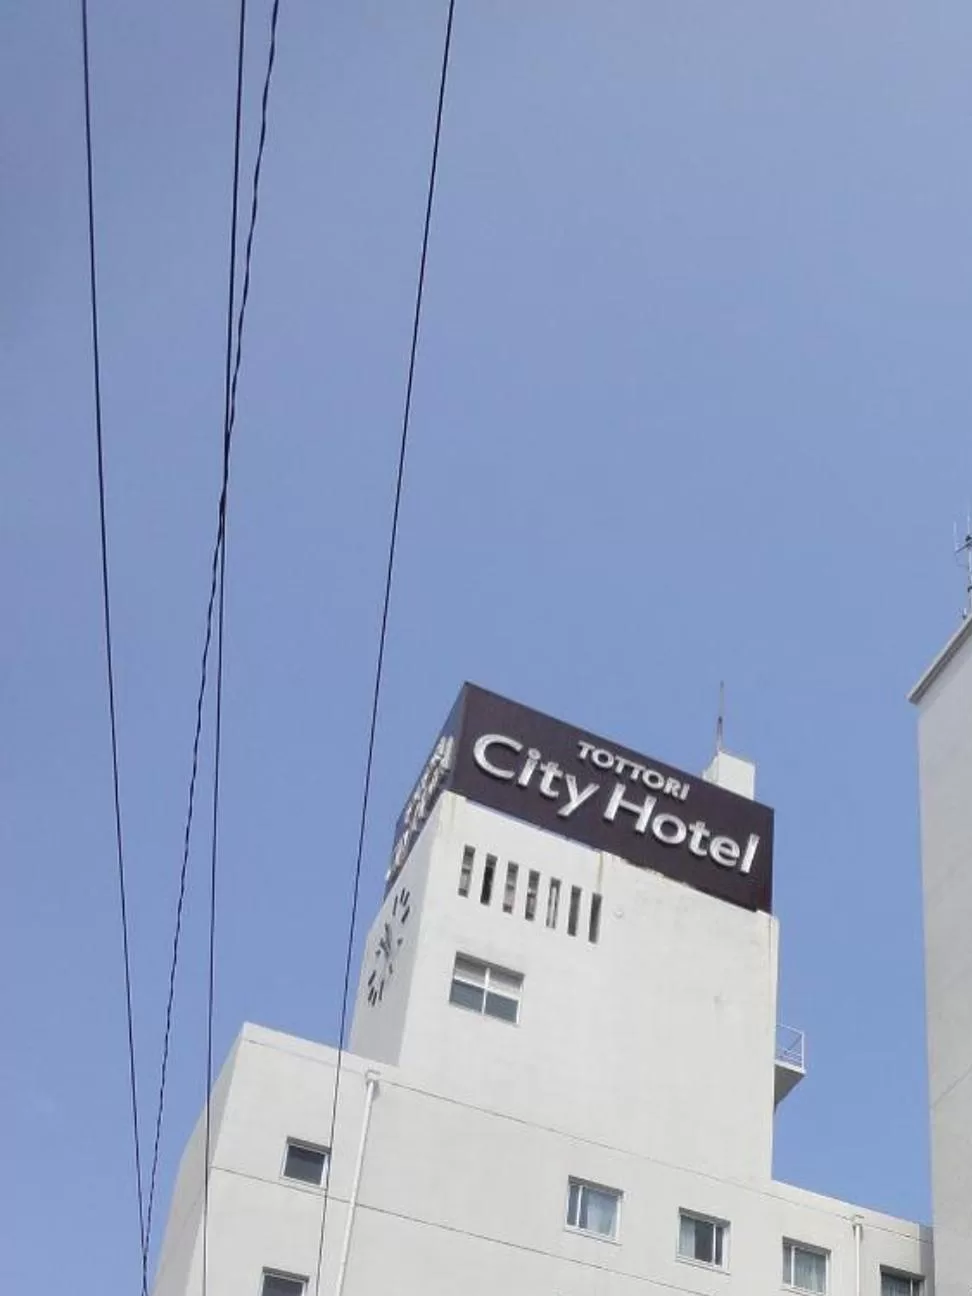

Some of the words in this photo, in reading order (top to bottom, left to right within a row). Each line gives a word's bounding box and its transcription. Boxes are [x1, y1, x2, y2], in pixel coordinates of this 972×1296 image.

[474, 733, 600, 818] City
[603, 782, 760, 875] Hotel
[577, 740, 690, 801] TOTTORI
